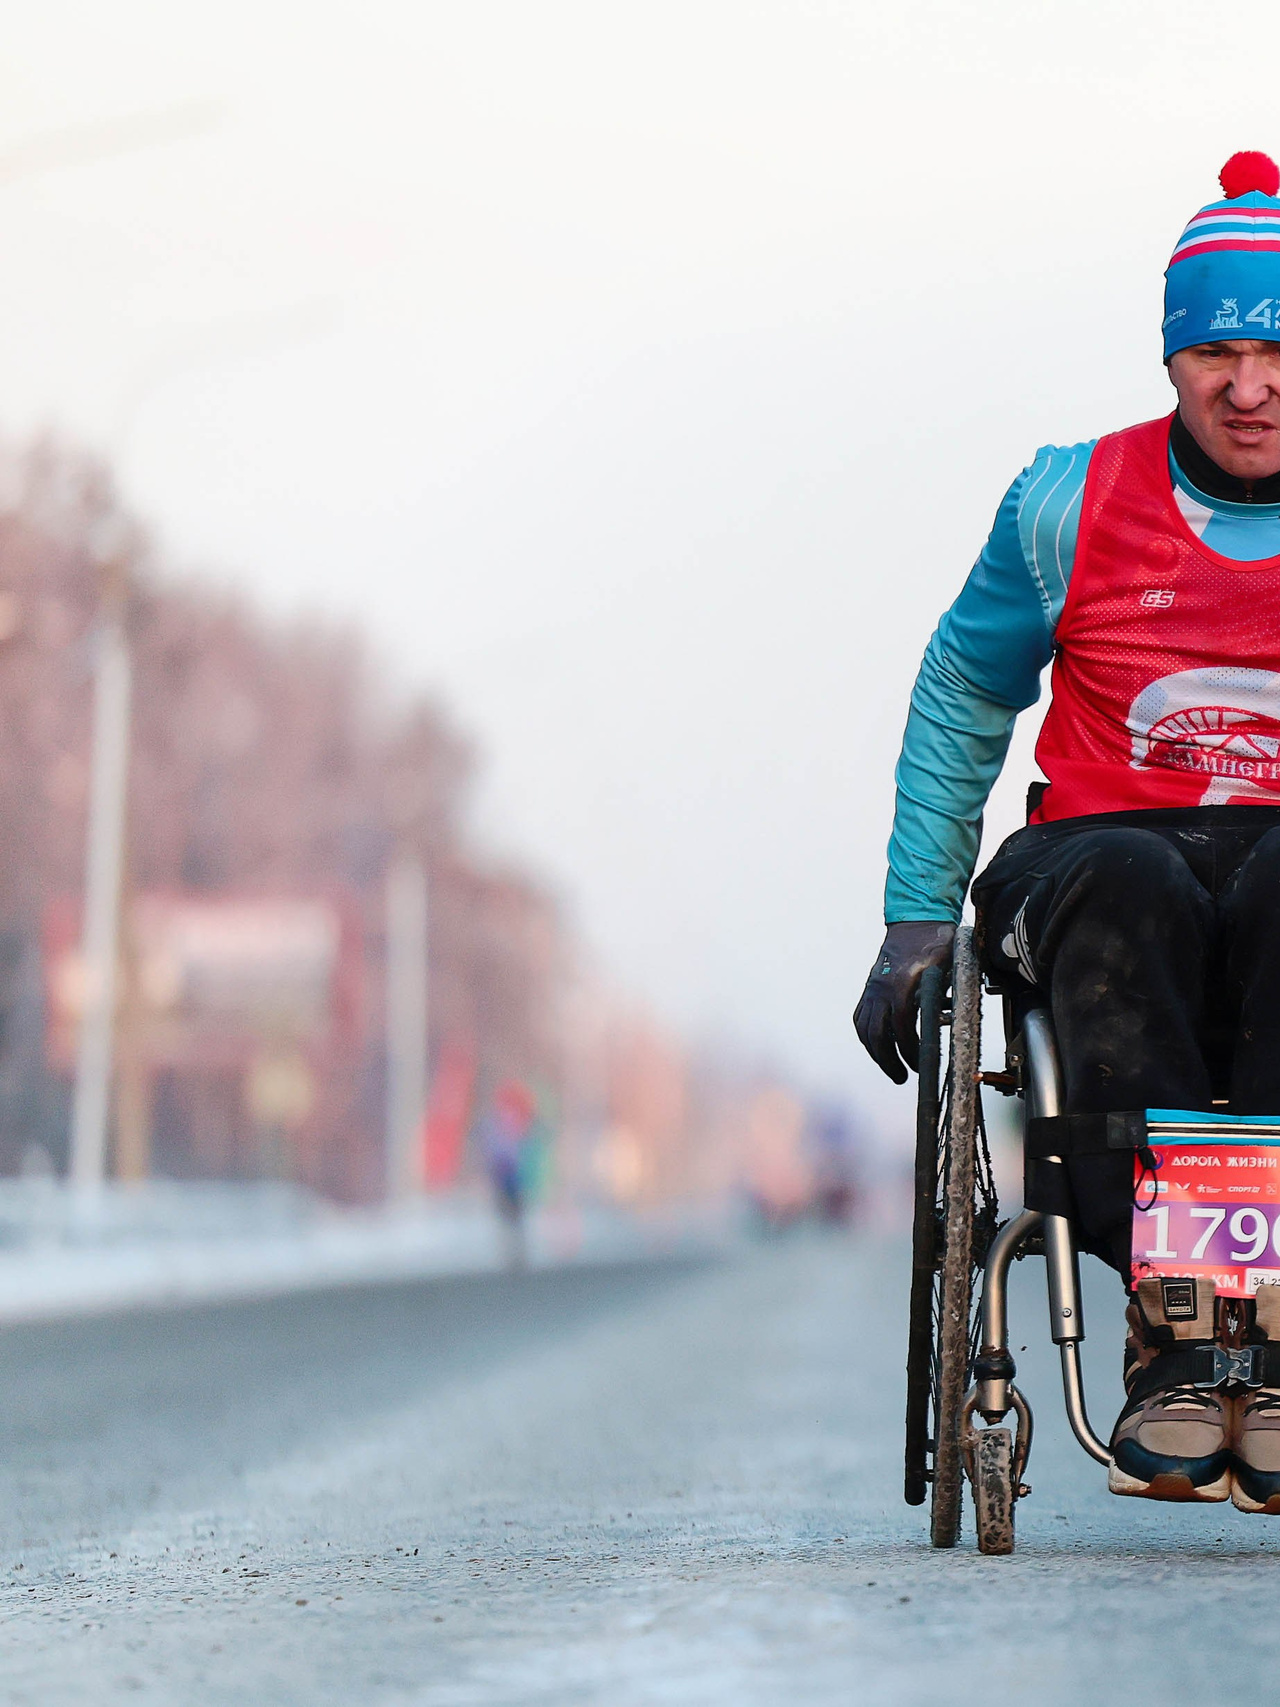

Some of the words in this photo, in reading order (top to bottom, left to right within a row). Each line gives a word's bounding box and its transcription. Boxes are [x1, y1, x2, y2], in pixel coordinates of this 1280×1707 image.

[1140, 589, 1176, 608] GS
[1171, 1155, 1222, 1168] ДОРОГА
[1226, 1156, 1278, 1169] ЖИЗНИ
